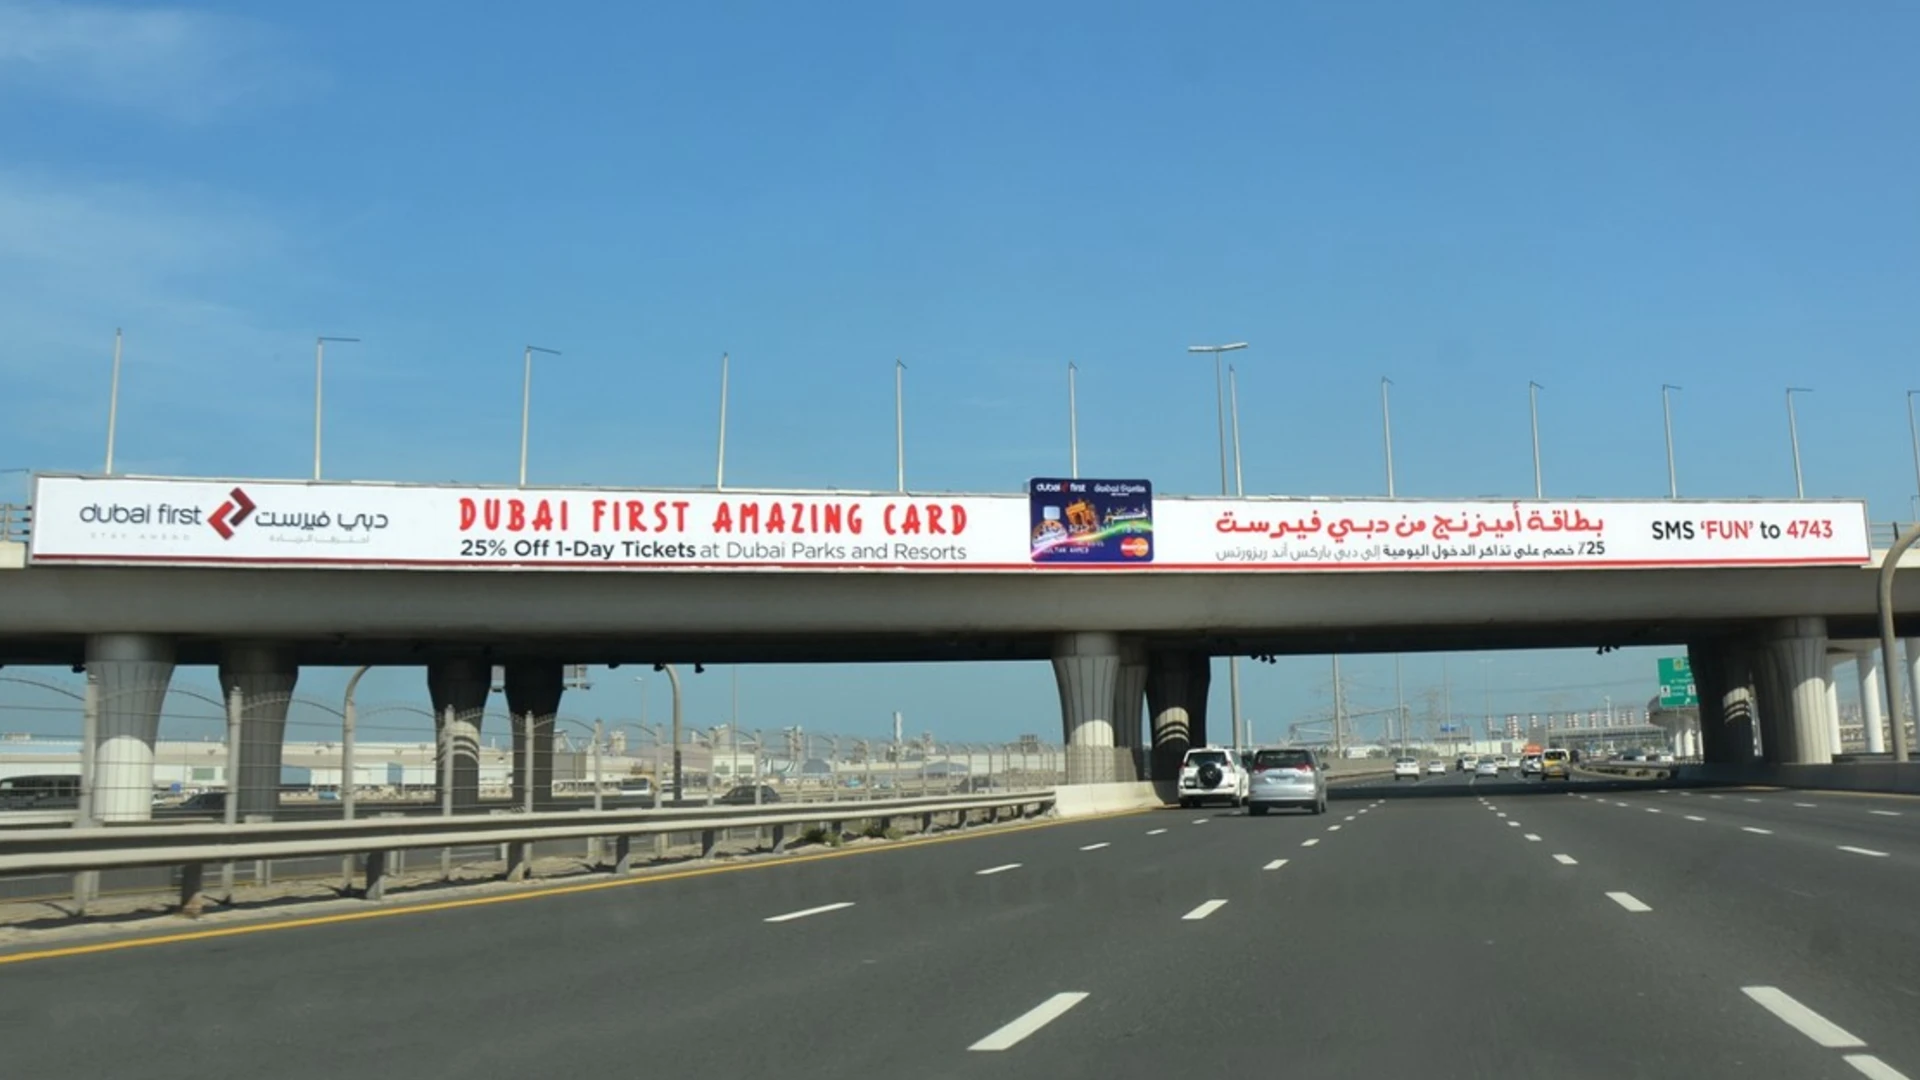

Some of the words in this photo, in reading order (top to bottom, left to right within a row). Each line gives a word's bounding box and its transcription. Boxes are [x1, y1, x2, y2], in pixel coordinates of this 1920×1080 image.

[80, 503, 151, 525] dubai
[158, 503, 203, 526] first
[254, 510, 331, 531] فيرست
[337, 513, 389, 532] دبي
[459, 498, 568, 532] DUBAI
[592, 499, 690, 533] FIRST
[712, 501, 863, 535] AMAZING
[883, 503, 967, 536] CARD
[1216, 510, 1322, 540] فيرست
[1432, 500, 1522, 540] أميزنج
[1527, 509, 1604, 537] بطاقة
[1327, 518, 1390, 543] دبي
[1395, 514, 1426, 538] من
[1652, 520, 1695, 540] SMS
[1760, 521, 1781, 540] to
[1786, 520, 1833, 539] 4743
[460, 539, 508, 557] 25%
[514, 539, 550, 557] Off
[555, 540, 615, 560] 1-Day
[621, 540, 696, 559] Tickets
[700, 542, 720, 559] at
[727, 541, 785, 559] Dubai
[792, 541, 846, 560] Parks
[851, 542, 888, 560] and
[895, 542, 967, 561] Resorts
[1383, 544, 1429, 560] اليومية
[1432, 544, 1475, 560] الدخول
[1543, 544, 1574, 559] خصم
